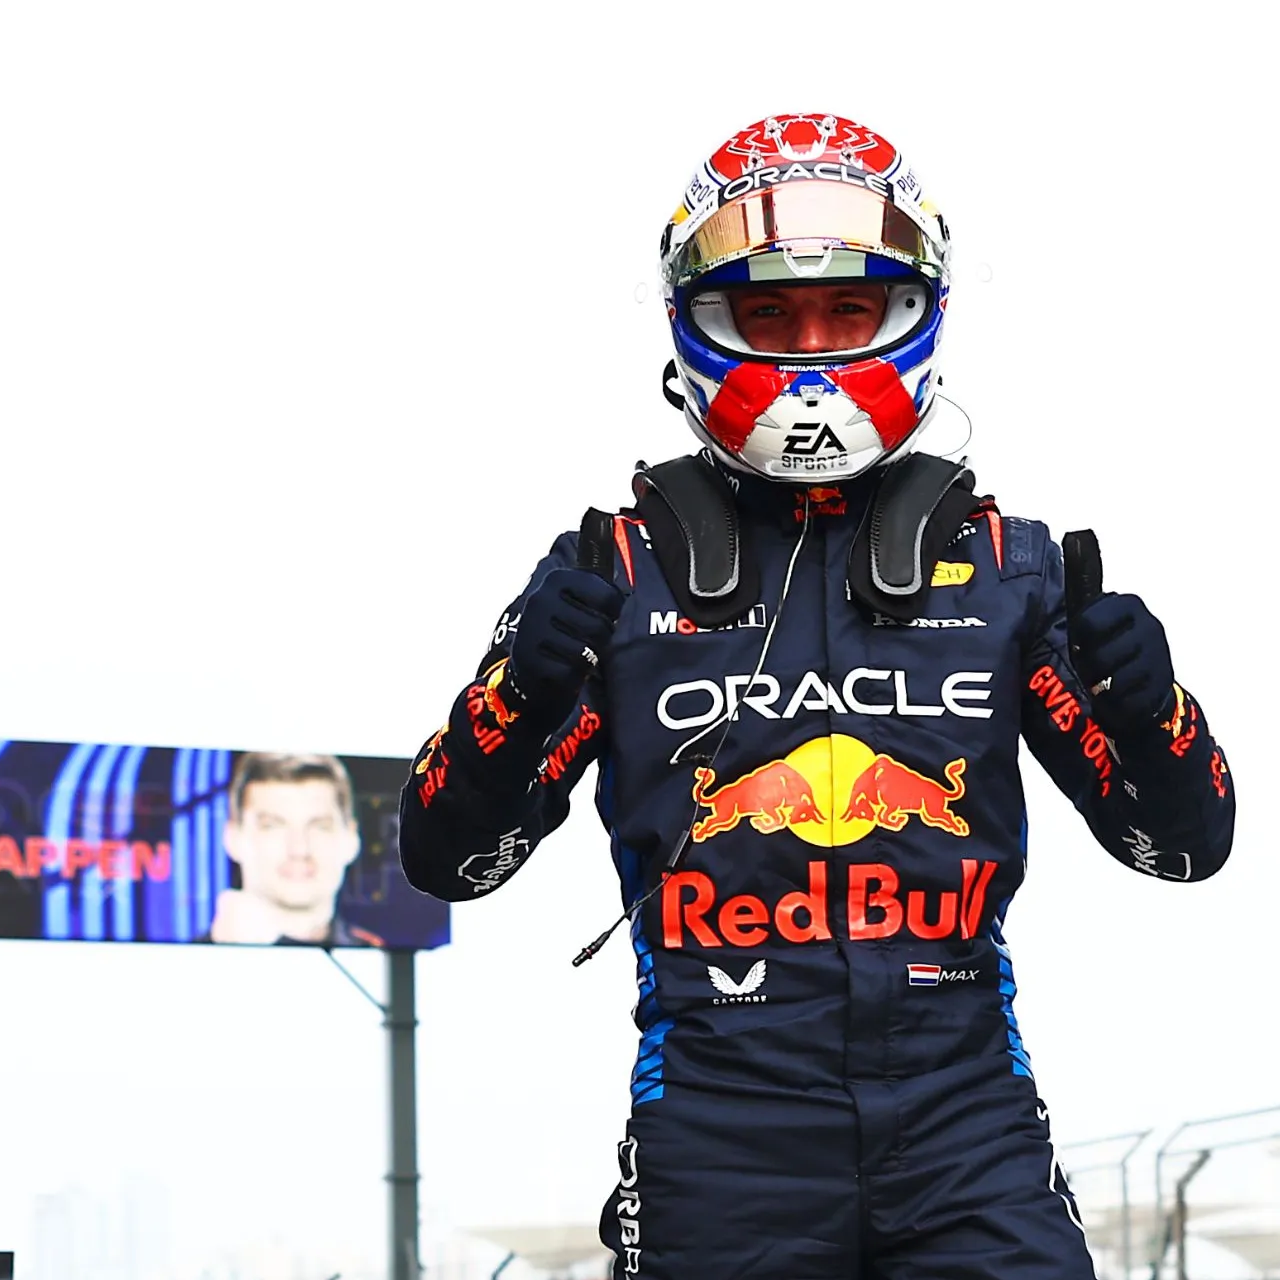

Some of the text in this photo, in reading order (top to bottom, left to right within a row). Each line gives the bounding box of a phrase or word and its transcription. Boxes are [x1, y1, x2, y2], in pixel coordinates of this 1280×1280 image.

[723, 162, 890, 200] ORACLE
[782, 422, 847, 455] EA
[781, 453, 848, 471] SPORTS
[656, 667, 995, 730] ORACLE
[1028, 664, 1081, 733] GIVES
[661, 858, 999, 949] Red Bull
[939, 968, 980, 983] MAX
